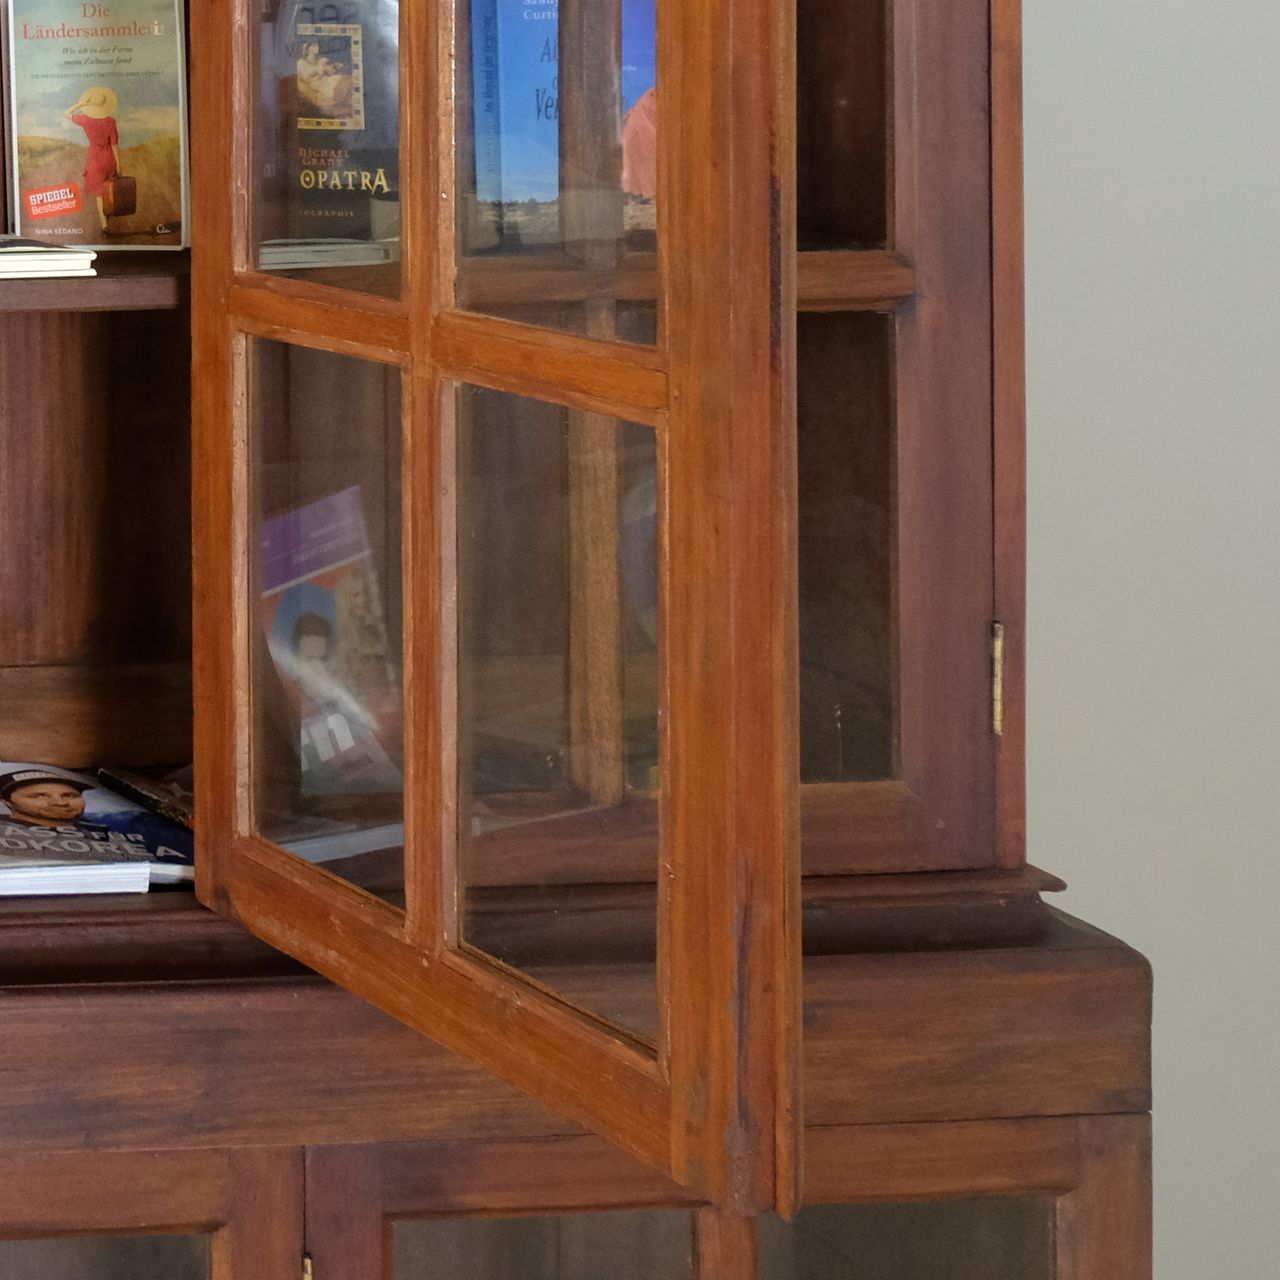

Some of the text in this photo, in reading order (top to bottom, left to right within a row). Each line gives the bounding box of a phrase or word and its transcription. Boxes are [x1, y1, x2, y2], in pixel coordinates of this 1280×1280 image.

[81, 2, 110, 18] Die
[300, 168, 392, 195] OPATRA
[29, 188, 75, 206] SPIEGEL
[31, 199, 77, 215] Bestseller
[3, 825, 82, 839] ASS
